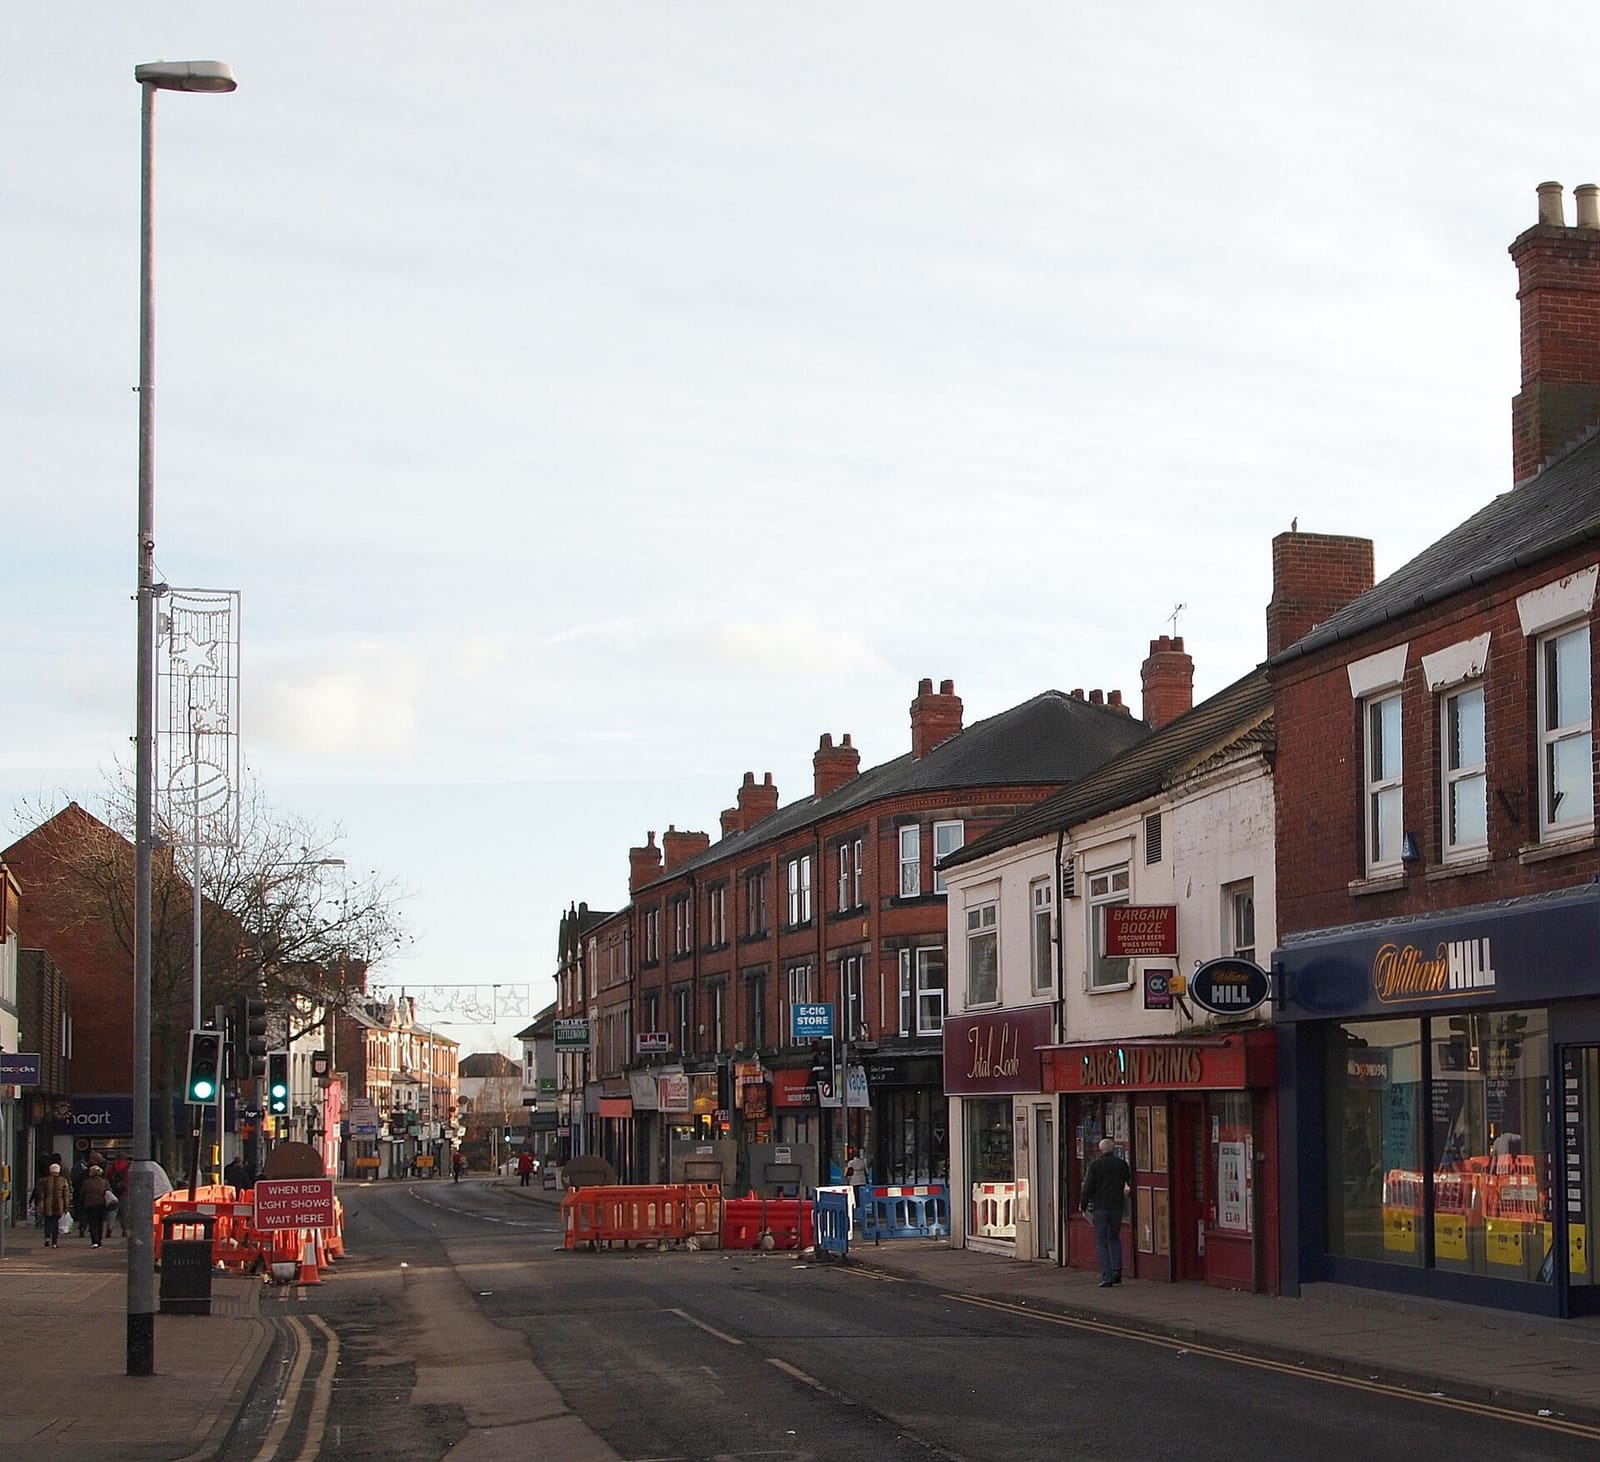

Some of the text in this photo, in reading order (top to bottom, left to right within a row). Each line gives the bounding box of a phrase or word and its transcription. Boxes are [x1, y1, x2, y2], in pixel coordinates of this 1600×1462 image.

[1113, 908, 1168, 921] BARGAIN
[1120, 922, 1162, 934] BOOZE
[1374, 937, 1496, 998] William HILL
[1211, 985, 1251, 1004] HILL
[800, 1006, 826, 1015] E-CIG
[797, 1016, 829, 1025] STORE
[966, 1022, 1020, 1079] Total Look
[1080, 1049, 1141, 1087] BARGAIN
[1146, 1047, 1204, 1083] DRINKS
[268, 1184, 321, 1195] WHEN RED
[291, 1199, 330, 1208] SHOWS
[265, 1213, 325, 1224] WAIT HERE
